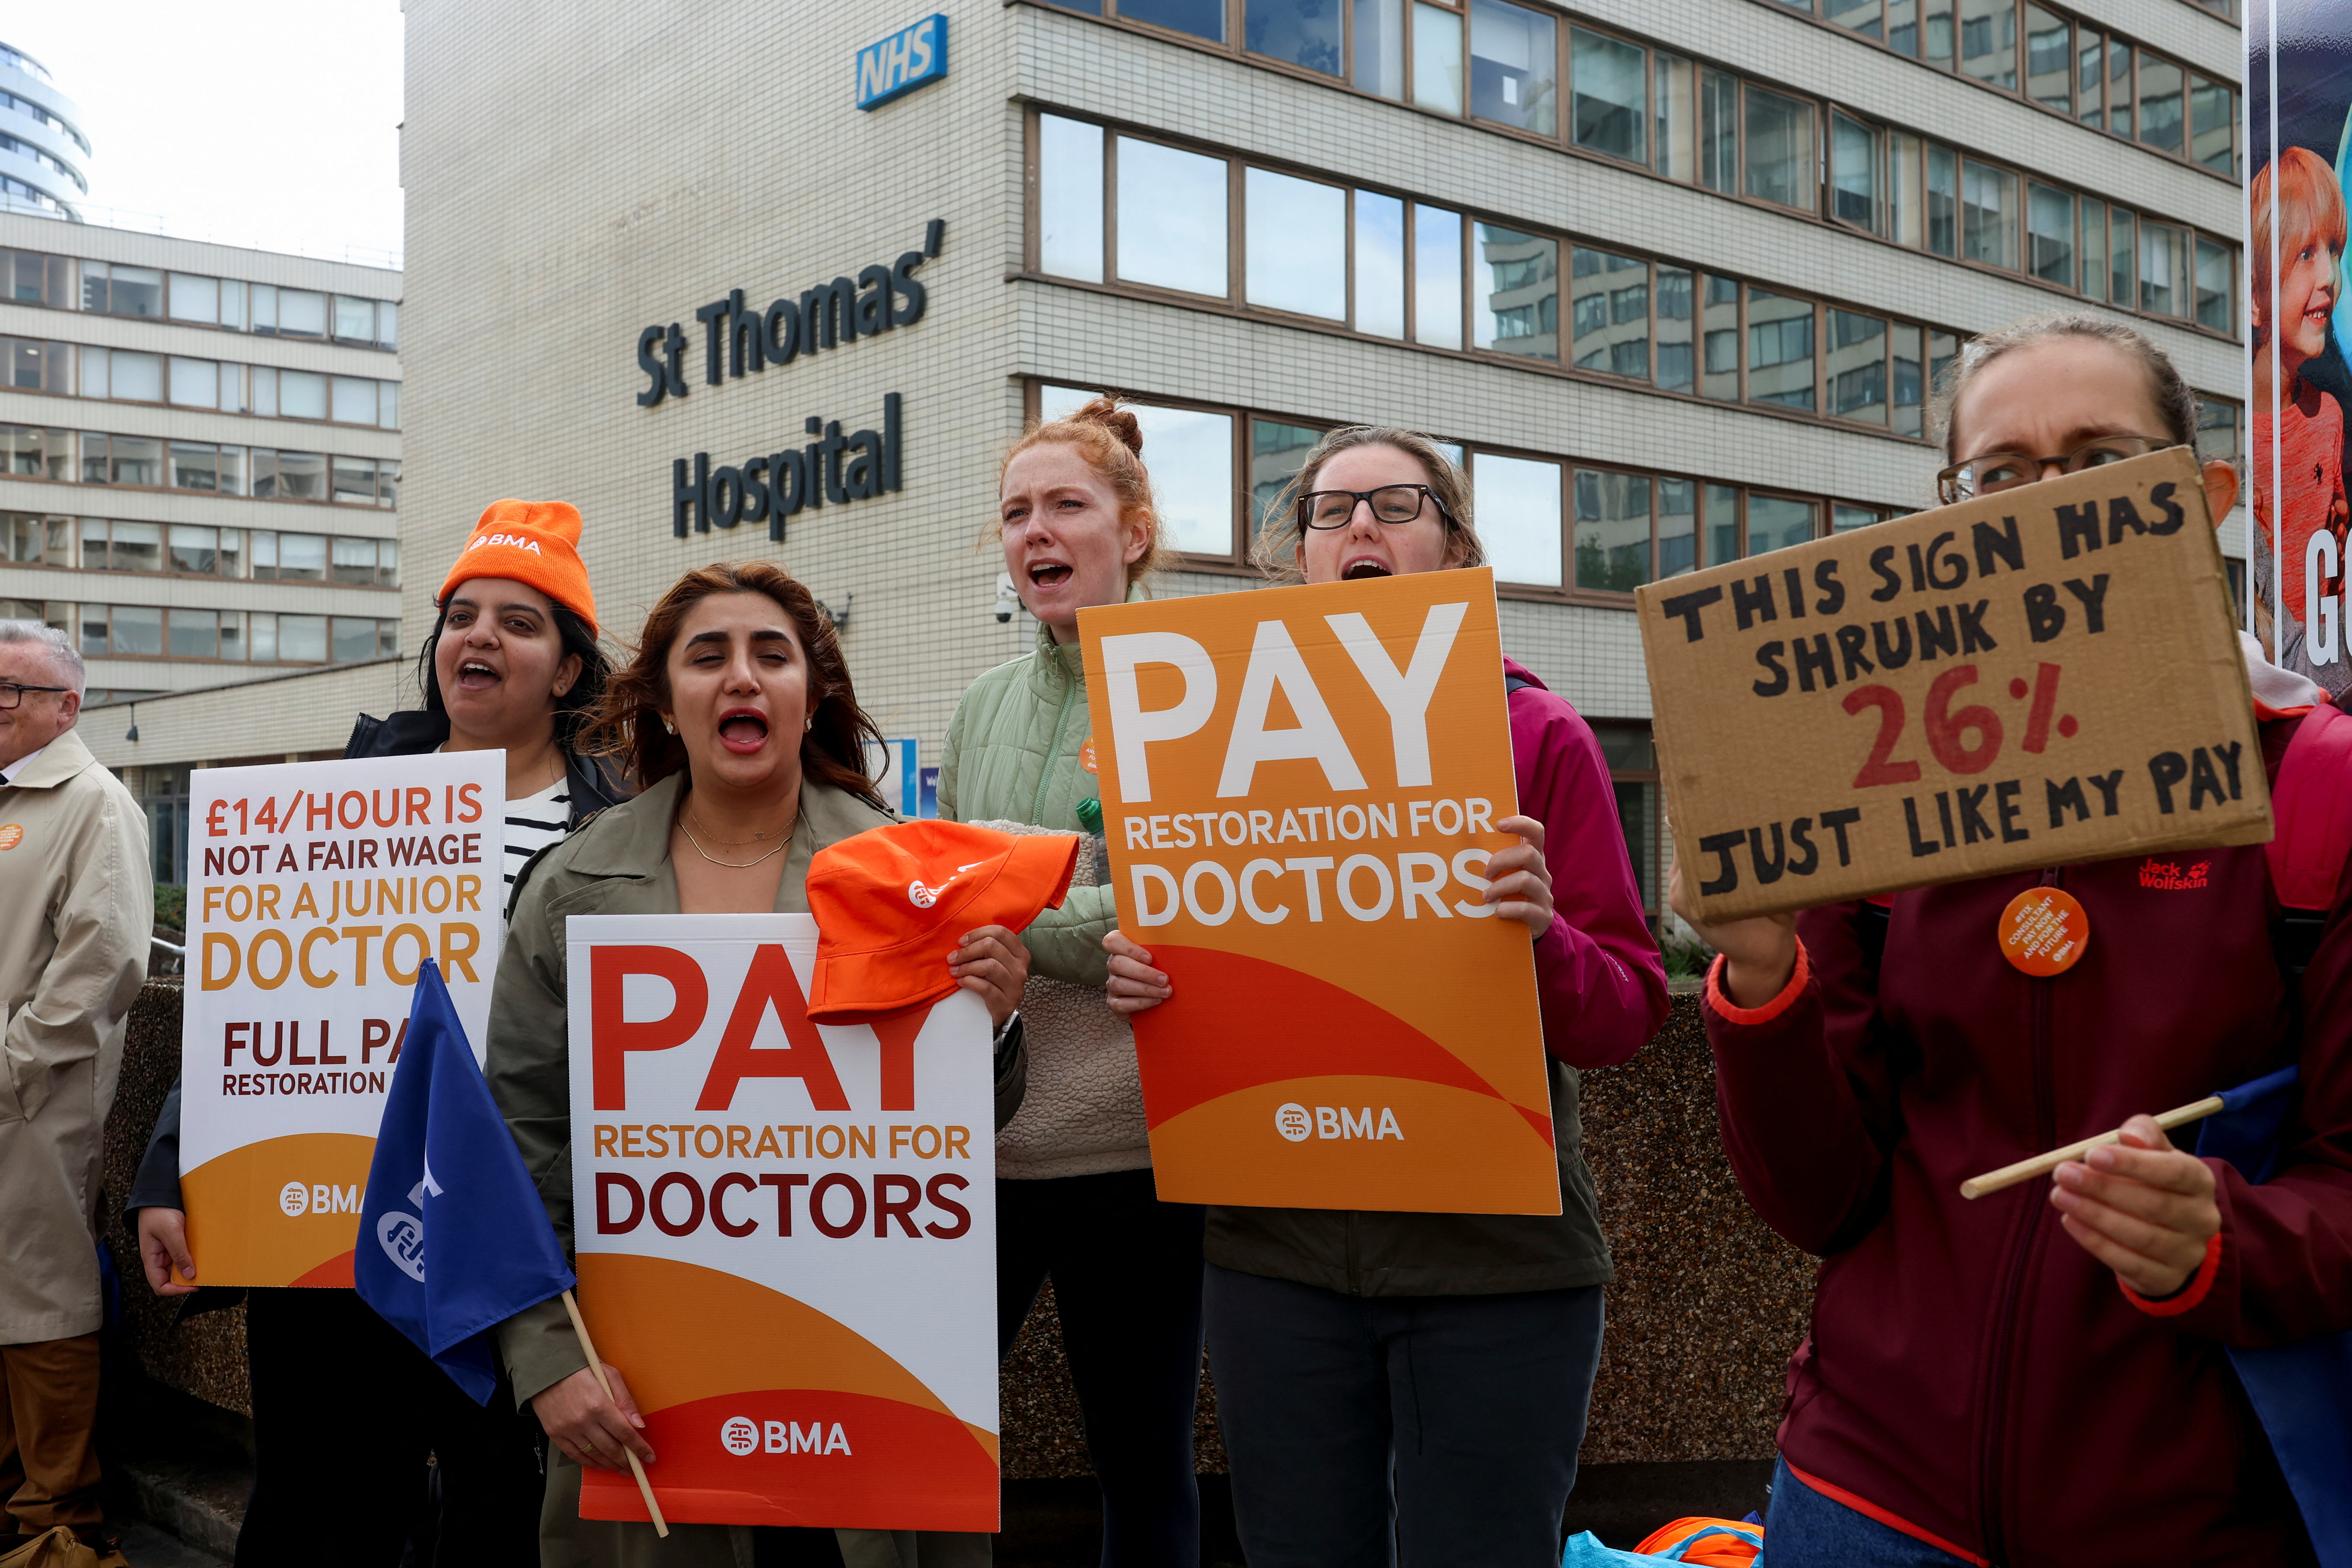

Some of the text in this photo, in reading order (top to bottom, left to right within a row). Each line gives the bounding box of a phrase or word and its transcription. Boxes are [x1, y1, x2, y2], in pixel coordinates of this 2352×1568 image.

[859, 20, 932, 103] NHS
[637, 218, 945, 406] St Thomas'
[673, 392, 902, 542] Hospital
[488, 534, 542, 555] BMA
[1661, 482, 2185, 642] THIS SIGN HAS
[2306, 529, 2352, 666] G
[1752, 573, 2111, 697] SHRUNK BY
[1100, 601, 1470, 804] PAY
[1841, 662, 2079, 789] 26%
[206, 783, 483, 837] £14/HOUR IS
[1124, 797, 1494, 850] RESTORATION FOR
[1699, 741, 2243, 897] JUST LIKE MY PAY
[204, 833, 482, 877] NOT A FAIR WAGE
[2139, 859, 2181, 877] Jack
[2139, 872, 2208, 889] Wolfskin
[203, 874, 482, 925] FOR A JUNIOR
[1130, 848, 1501, 927] DOCTORS
[2008, 895, 2054, 945] CONSULTANT
[2022, 909, 2054, 945] PAY NOW
[2024, 909, 2070, 960] AND FOR THE
[2038, 924, 2069, 957] FUTURE
[201, 921, 481, 991] DOCTOR
[224, 1018, 410, 1067] FULL PA
[222, 1071, 384, 1096] RESTORATION
[594, 1124, 971, 1160] RESTORATION FOR
[1318, 1106, 1405, 1141] BMA
[596, 1172, 972, 1240] DOCTORS
[764, 1421, 852, 1456] BMA
